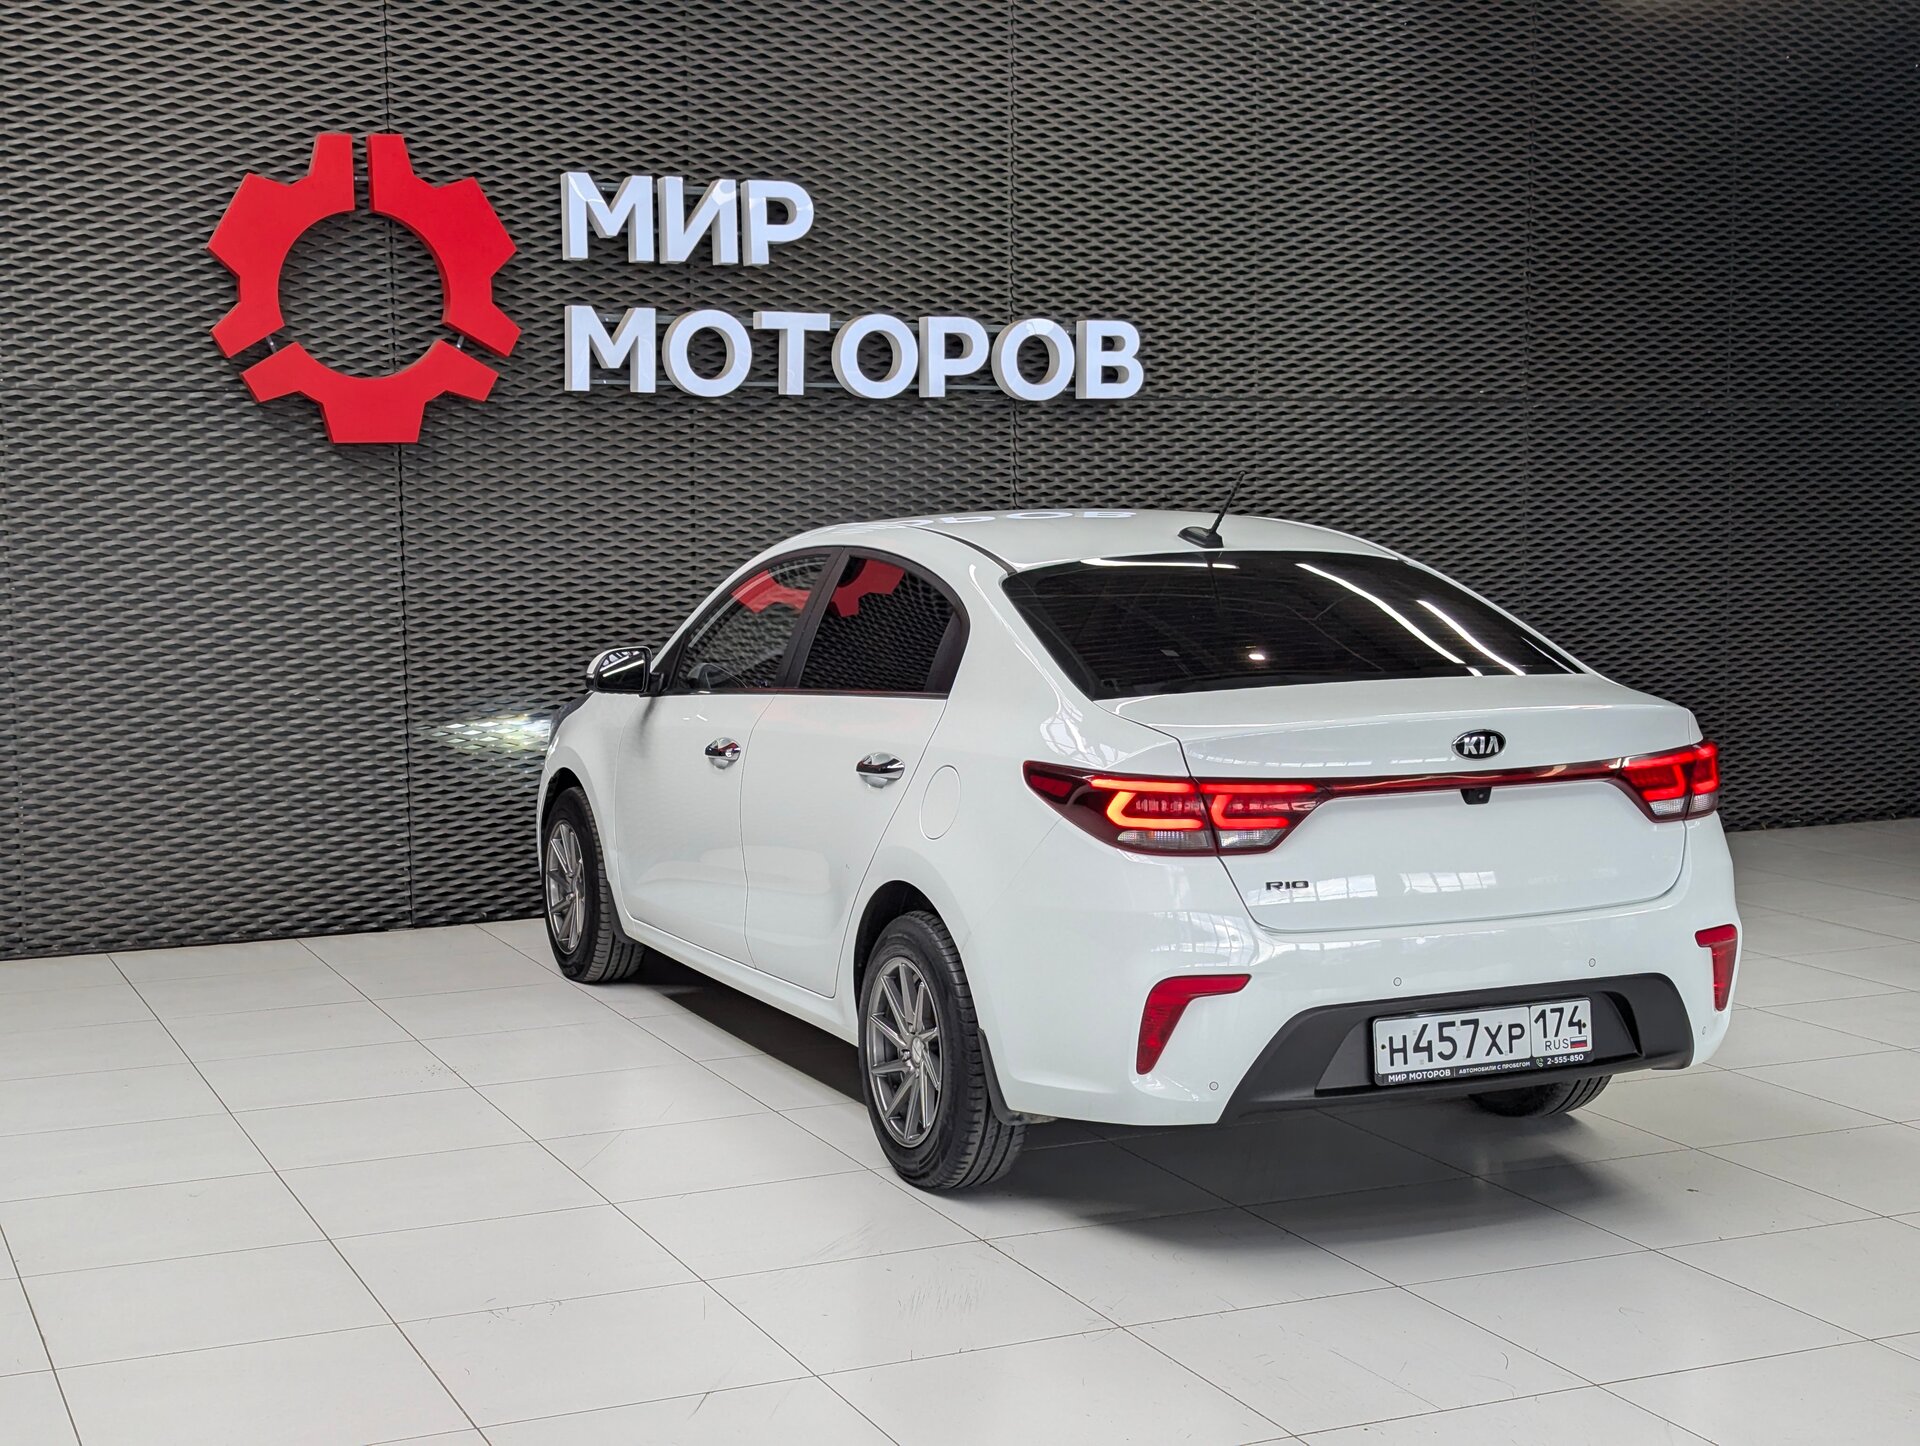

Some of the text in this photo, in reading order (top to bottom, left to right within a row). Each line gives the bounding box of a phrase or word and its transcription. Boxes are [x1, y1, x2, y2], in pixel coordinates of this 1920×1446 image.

[560, 172, 814, 266] МИР
[564, 305, 1144, 401] МОТОРОВ
[1463, 735, 1499, 755] KIA
[1265, 880, 1309, 891] RIO
[1533, 1005, 1583, 1039] 174
[1544, 1038, 1569, 1051] RUS
[1546, 1053, 1585, 1065] 2-555-850
[1458, 1065, 1497, 1074] АВТОМОБИЛИ
[1501, 1061, 1531, 1070] ПРОБЕГОМ
[1388, 1069, 1451, 1083] МИР МОТОРОВ
